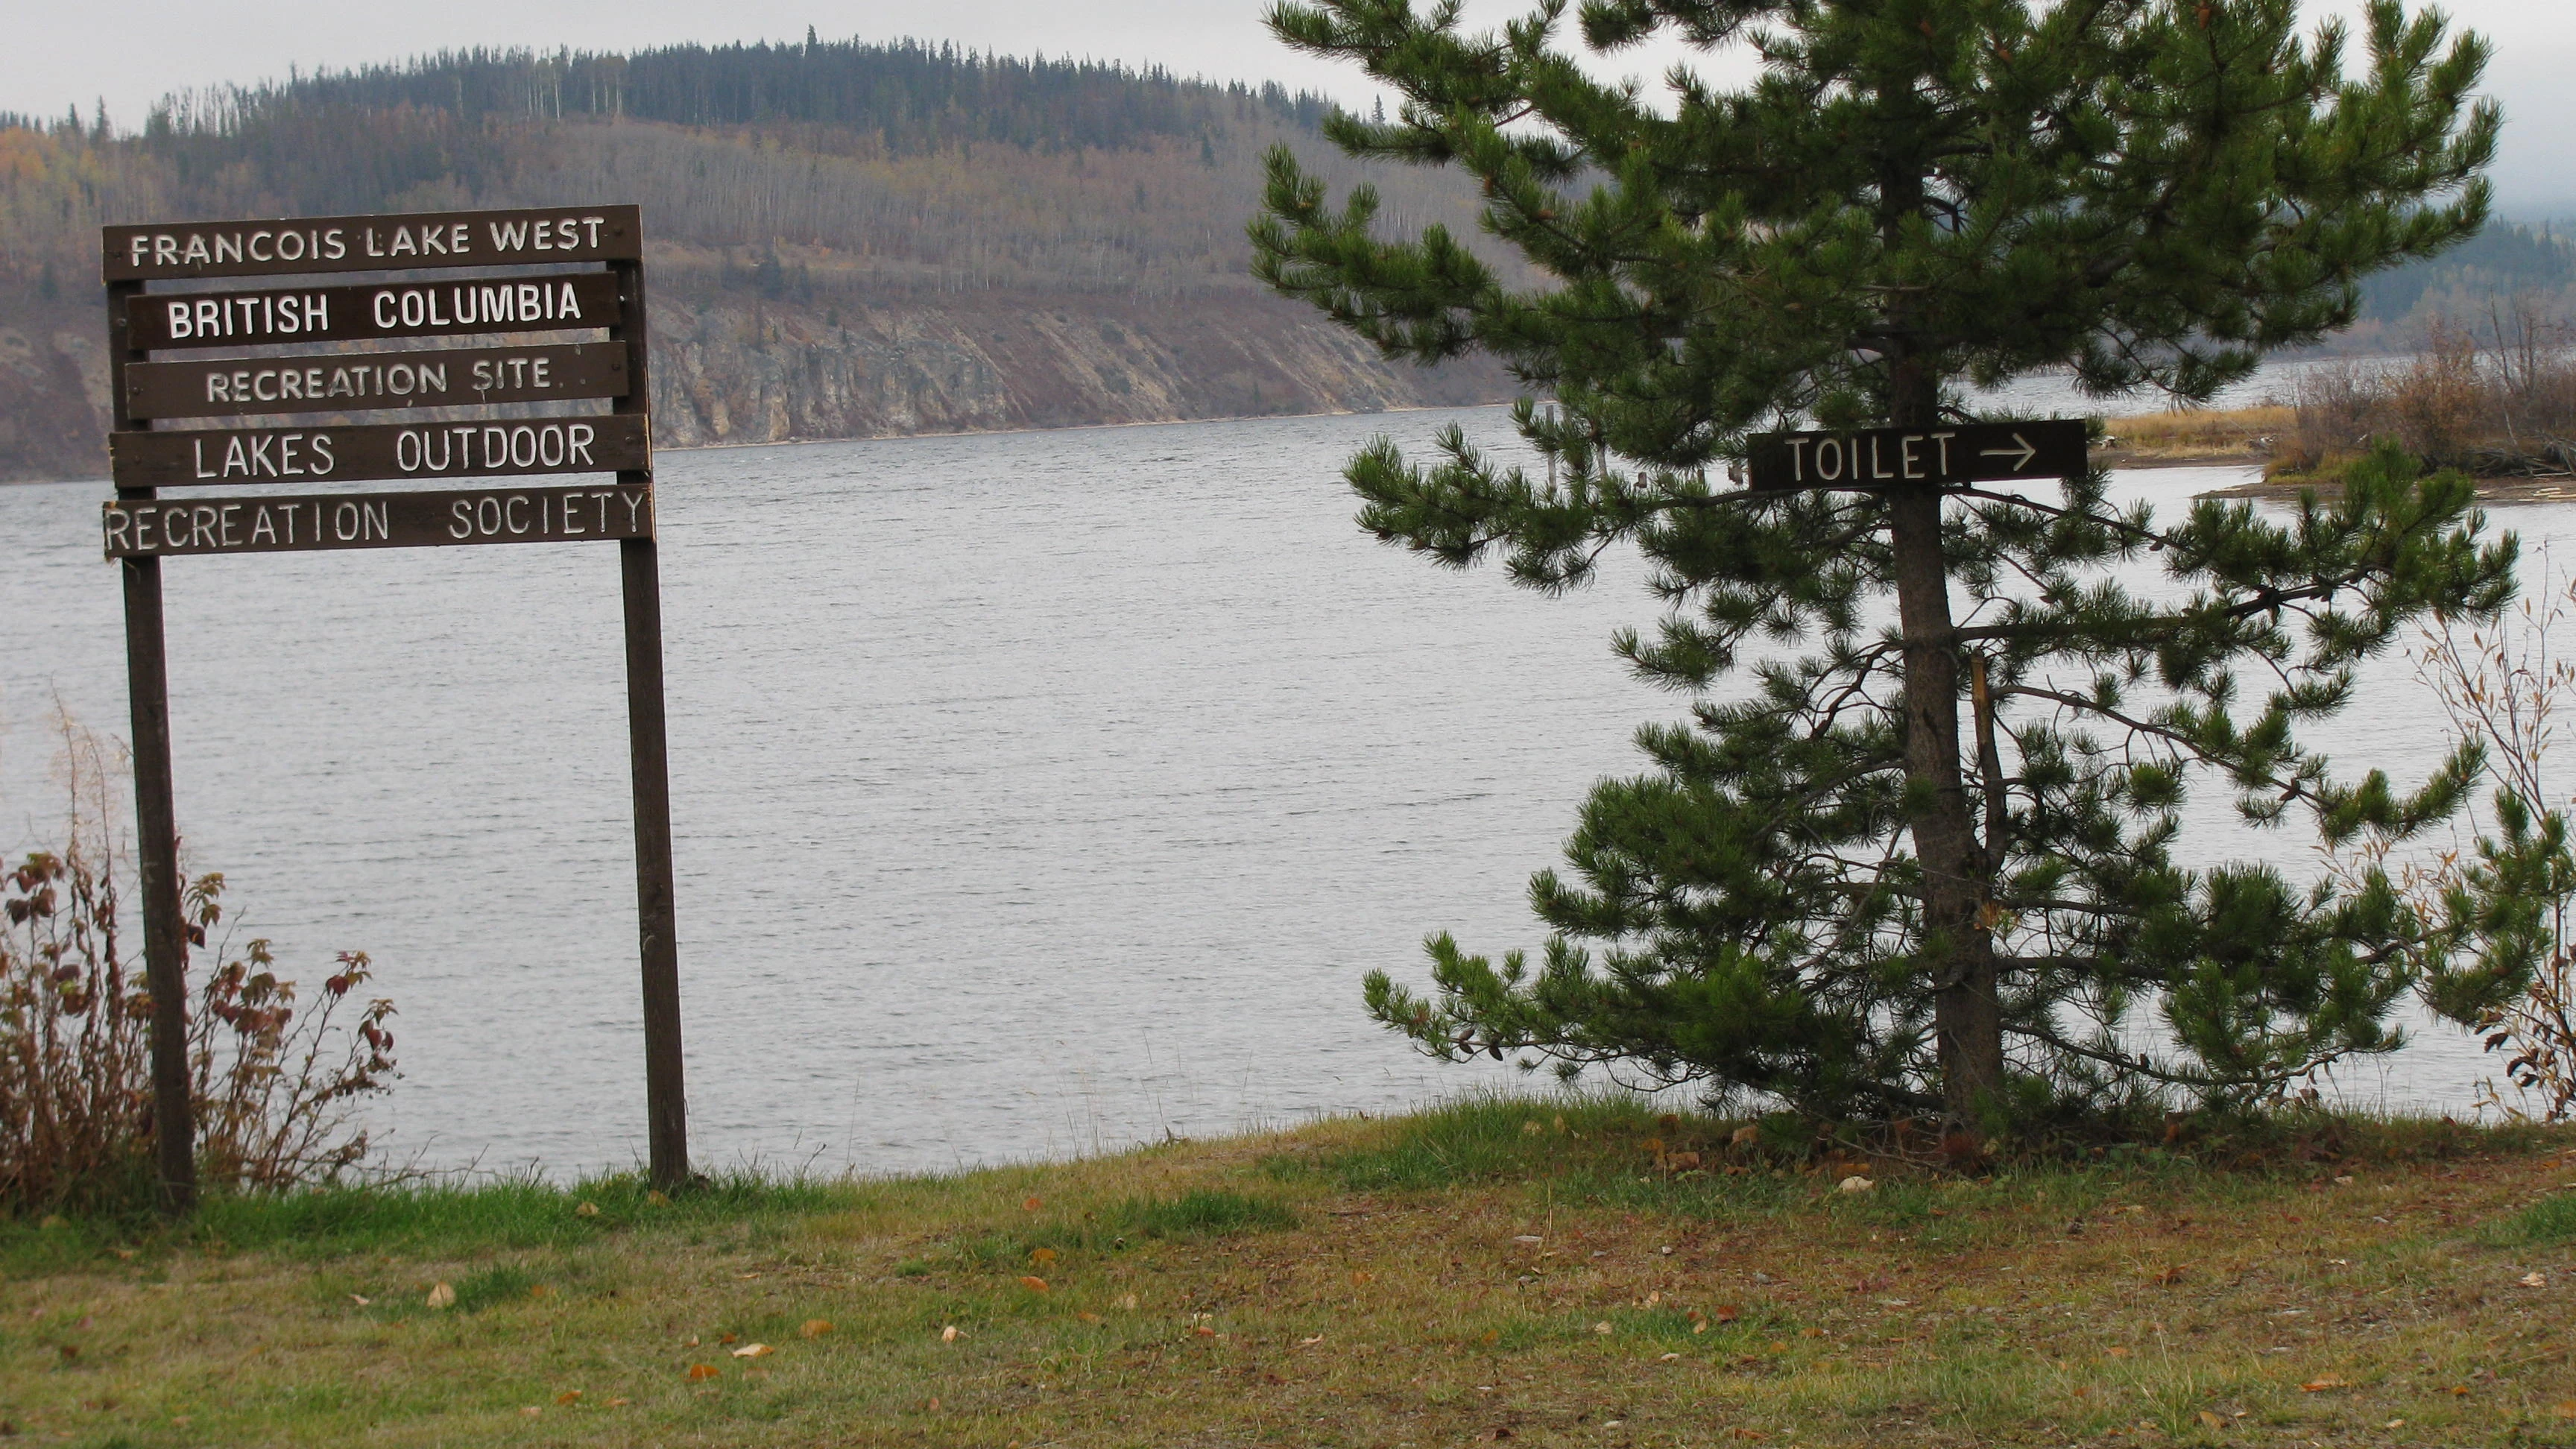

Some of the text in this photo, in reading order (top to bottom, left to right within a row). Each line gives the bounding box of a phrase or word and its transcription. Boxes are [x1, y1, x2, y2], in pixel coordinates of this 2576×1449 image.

[130, 217, 605, 267] FRANCOIS LAKE WEST
[168, 282, 582, 339] BRITISH COLUMBIA
[206, 358, 551, 403] RECREATION SITE
[194, 424, 596, 479] LAKES OUTDOOR
[1784, 432, 1956, 482] TOILET
[104, 490, 644, 552] RECREATION SOCIETY
